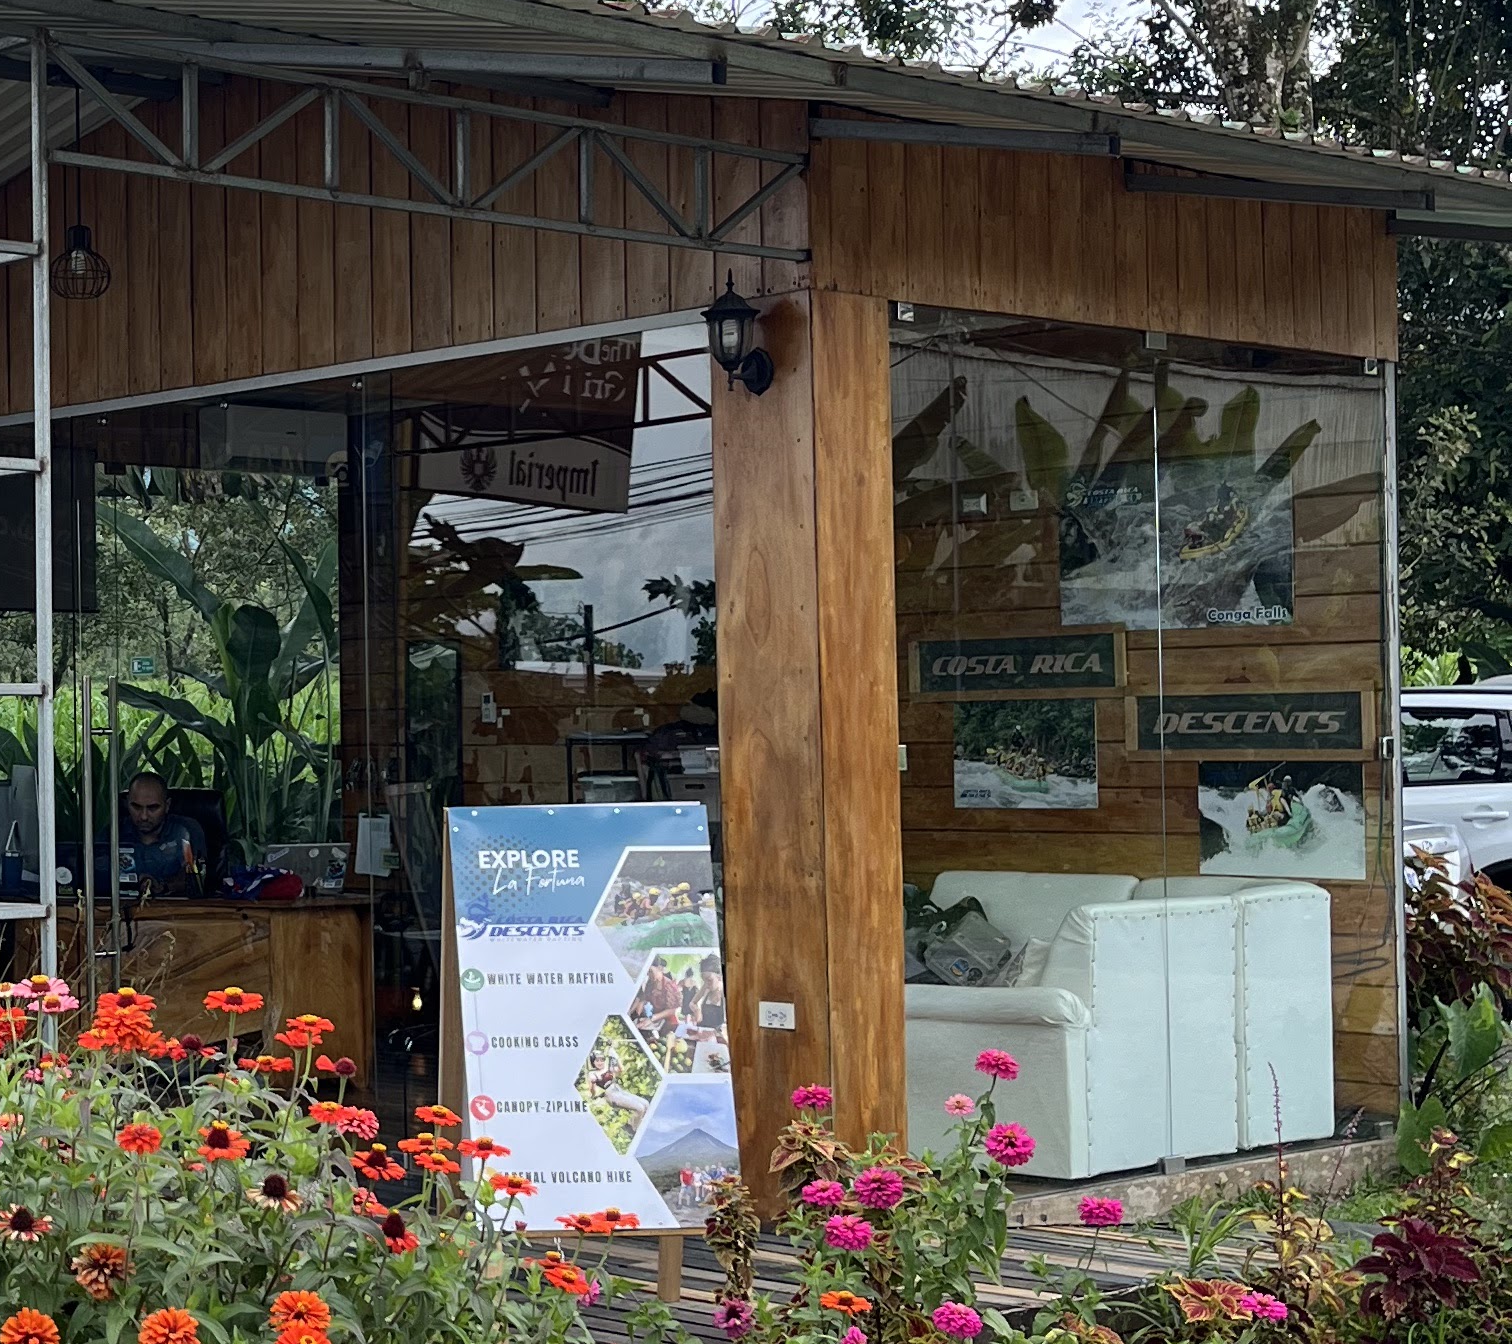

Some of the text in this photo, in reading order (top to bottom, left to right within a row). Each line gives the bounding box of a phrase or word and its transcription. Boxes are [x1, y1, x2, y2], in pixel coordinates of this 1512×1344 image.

[1207, 605, 1288, 622] Conga Falls
[931, 652, 1104, 677] COSTA RICA
[1151, 710, 1349, 735] DESCENTS
[478, 849, 580, 869] EXPLORE
[492, 864, 586, 896] La Fortuna
[489, 925, 587, 937] DESCENTS
[487, 972, 614, 985] WHITE WATER RAFTING
[491, 1036, 579, 1048] COOKING CLASS
[496, 1100, 589, 1113] CANOPY-ZIPLINE
[551, 1171, 602, 1184] VOLCANO
[607, 1170, 632, 1183] HIKE
